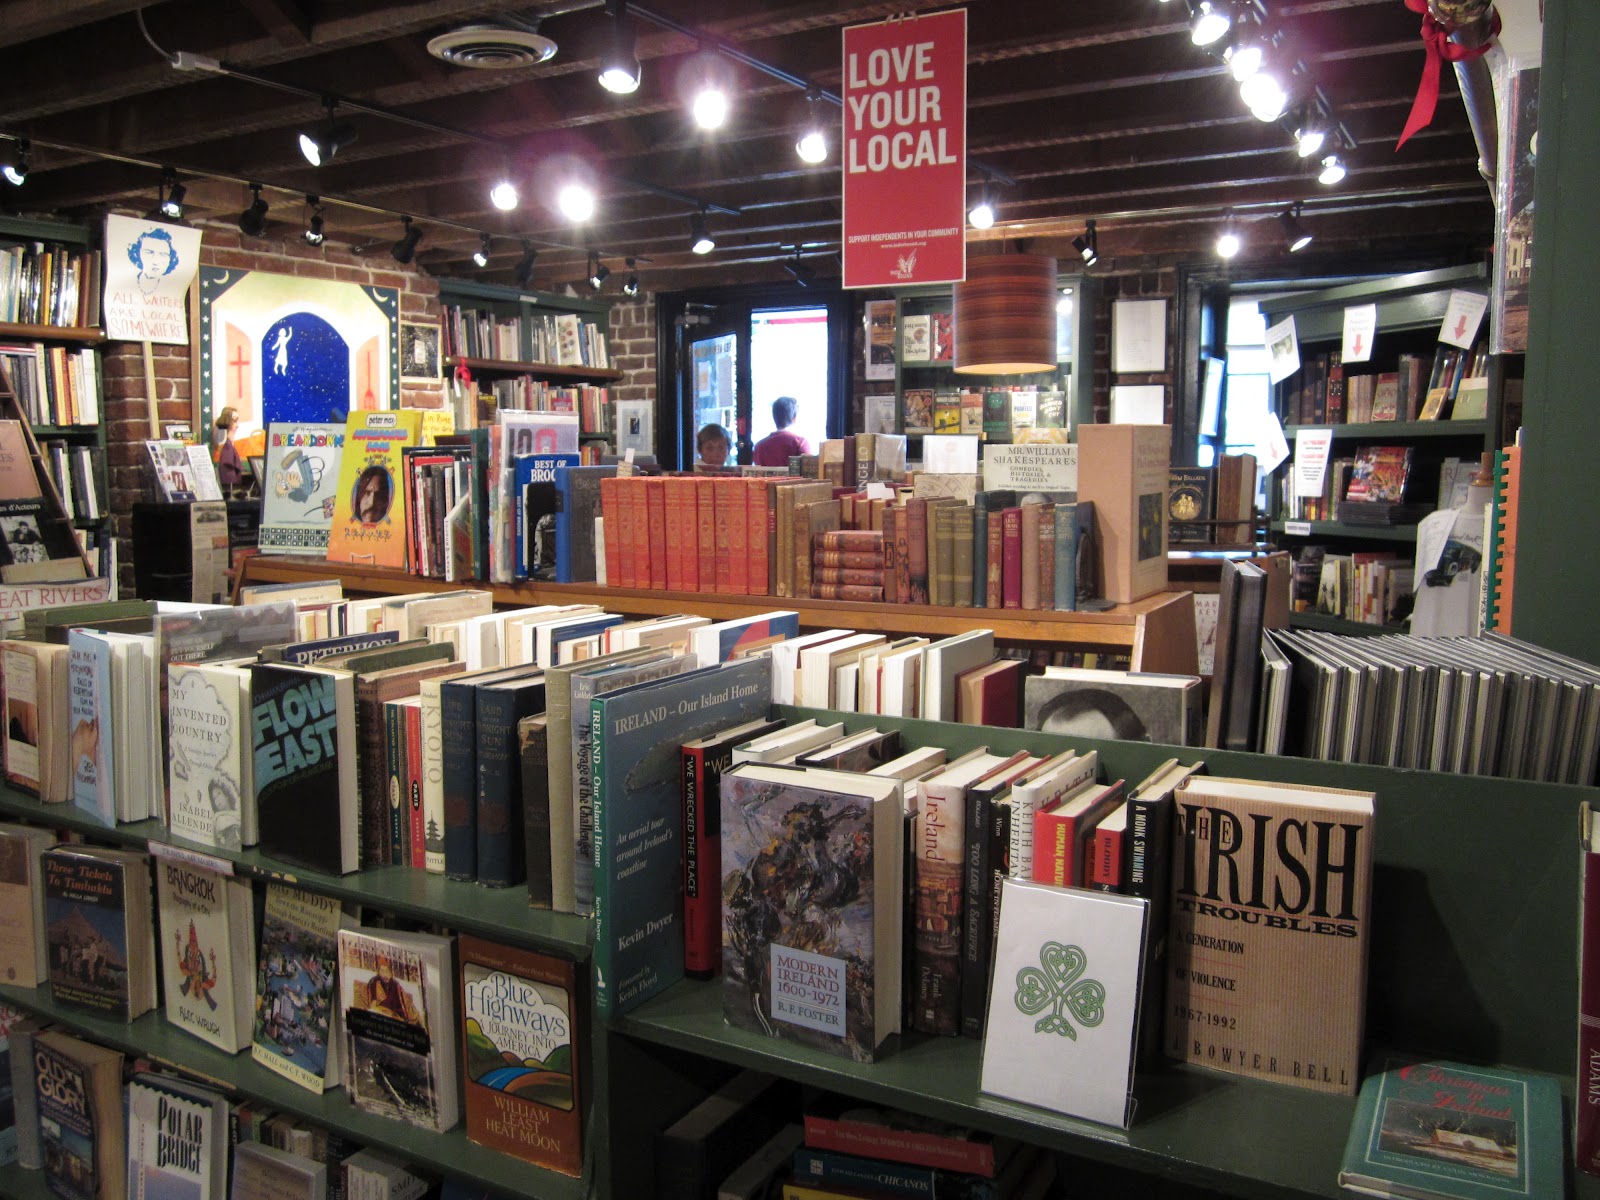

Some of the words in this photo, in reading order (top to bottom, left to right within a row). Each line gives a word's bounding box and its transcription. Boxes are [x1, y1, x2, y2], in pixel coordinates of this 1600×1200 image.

[849, 41, 934, 89] LOVE
[848, 85, 941, 130] YOUR
[849, 127, 957, 174] LOCAL
[848, 234, 871, 243] SUPPORT
[870, 231, 907, 242] INDEPENDENTS
[914, 229, 928, 238] YOUR
[928, 227, 959, 237] COMMUNITY
[110, 307, 137, 317] ARE
[141, 310, 180, 322] LOCAL
[112, 292, 133, 304] ALL
[143, 294, 184, 309] WRITERS
[110, 317, 184, 338] SOMEWHERE
[368, 415, 383, 425] peter
[534, 460, 554, 468] BEST
[557, 459, 567, 467] OF
[993, 456, 1077, 465] SHAKESPEARES
[1026, 447, 1070, 456] WILLIAM
[40, 586, 104, 606] RIVERS
[172, 689, 188, 701] MY
[172, 704, 227, 726] INVENTED
[252, 675, 337, 748] FLOW
[615, 706, 667, 736] IRELAND
[678, 700, 698, 716] Our
[700, 690, 729, 710] Island
[731, 683, 759, 702] Home
[172, 723, 223, 743] COUNTRY
[427, 705, 443, 784] KYOTO
[481, 734, 502, 747] SUN
[592, 709, 602, 764] IRELAND
[253, 713, 337, 795] EAST
[578, 744, 590, 776] Voyage
[686, 755, 695, 777] "WE
[579, 777, 591, 787] of
[593, 776, 602, 798] Our
[579, 789, 591, 804] the
[686, 782, 695, 834] WRECKED
[171, 812, 213, 833] ALLENDE
[179, 802, 213, 820] ISABEL
[594, 800, 603, 833] Island
[1022, 802, 1034, 848] KEITH
[578, 805, 593, 858] Challenger
[616, 832, 628, 846] An
[628, 821, 650, 840] aerial
[650, 815, 665, 829] tour
[925, 794, 946, 861] Ireland
[995, 817, 1003, 837] Winn
[1055, 823, 1066, 857] HUMAN
[1134, 813, 1147, 839] MONK
[1176, 813, 1232, 845] THE
[594, 834, 603, 868] Home
[616, 844, 643, 862] around
[644, 829, 673, 852] Ireland's
[687, 835, 696, 857] THE
[968, 843, 981, 866] TOO
[1103, 837, 1112, 878] BLOODY
[47, 859, 74, 875] Three
[79, 865, 113, 883] Tickets
[616, 859, 648, 881] coastline
[1132, 840, 1145, 883] SWIMMING
[1176, 803, 1364, 921] IRISH
[49, 873, 61, 887] To
[64, 877, 113, 896] Timbuktu
[166, 866, 216, 903] BANGKOK
[688, 858, 696, 897] PLACE"
[968, 867, 980, 895] LONG
[992, 868, 1001, 894] HOME
[270, 881, 293, 894] BIG
[293, 886, 336, 914] MUDDY
[993, 895, 1001, 905] IN
[287, 910, 310, 928] America's
[618, 928, 645, 951] Kevin
[646, 912, 674, 936] Dwyer
[1176, 899, 1358, 938] TROUBLES
[968, 908, 981, 963] SACRIFICE
[1185, 932, 1245, 955] GENERATION
[777, 954, 839, 979] MODERN
[777, 967, 840, 993] IRELAND
[1175, 969, 1188, 983] OF
[1191, 971, 1236, 992] VIOLENCE
[490, 971, 537, 1007] Blue
[618, 985, 638, 1003] Keith
[638, 972, 658, 992] Floyd
[777, 981, 840, 1006] 1600-1972
[932, 972, 942, 1000] Frank
[179, 1006, 195, 1026] ALEC
[469, 984, 566, 1037] Highways
[778, 1001, 788, 1011] R.
[789, 1003, 797, 1014] F.
[798, 1007, 840, 1026] FOSTER
[1173, 1005, 1237, 1030] 1967-1992
[487, 1021, 529, 1042] JOURNEY
[532, 1033, 557, 1050] INTO
[494, 1036, 541, 1058] AMERICA
[36, 1051, 66, 1085] OLD
[264, 1053, 279, 1068] HALL
[279, 1060, 288, 1071] and
[301, 1071, 321, 1089] WOOD
[1193, 1040, 1278, 1073] BOWYER
[1293, 1061, 1349, 1086] BELL
[1588, 1048, 1600, 1104] ADAMS
[37, 1073, 86, 1116] GLORY
[158, 1096, 203, 1144] POLAR
[494, 1095, 550, 1124] WILLIAM
[503, 1112, 540, 1133] LEAST
[486, 1118, 515, 1139] HEAT
[520, 1130, 561, 1152] MOON
[157, 1131, 202, 1175] BRIDGE
[878, 1174, 929, 1191] CHICANOS
